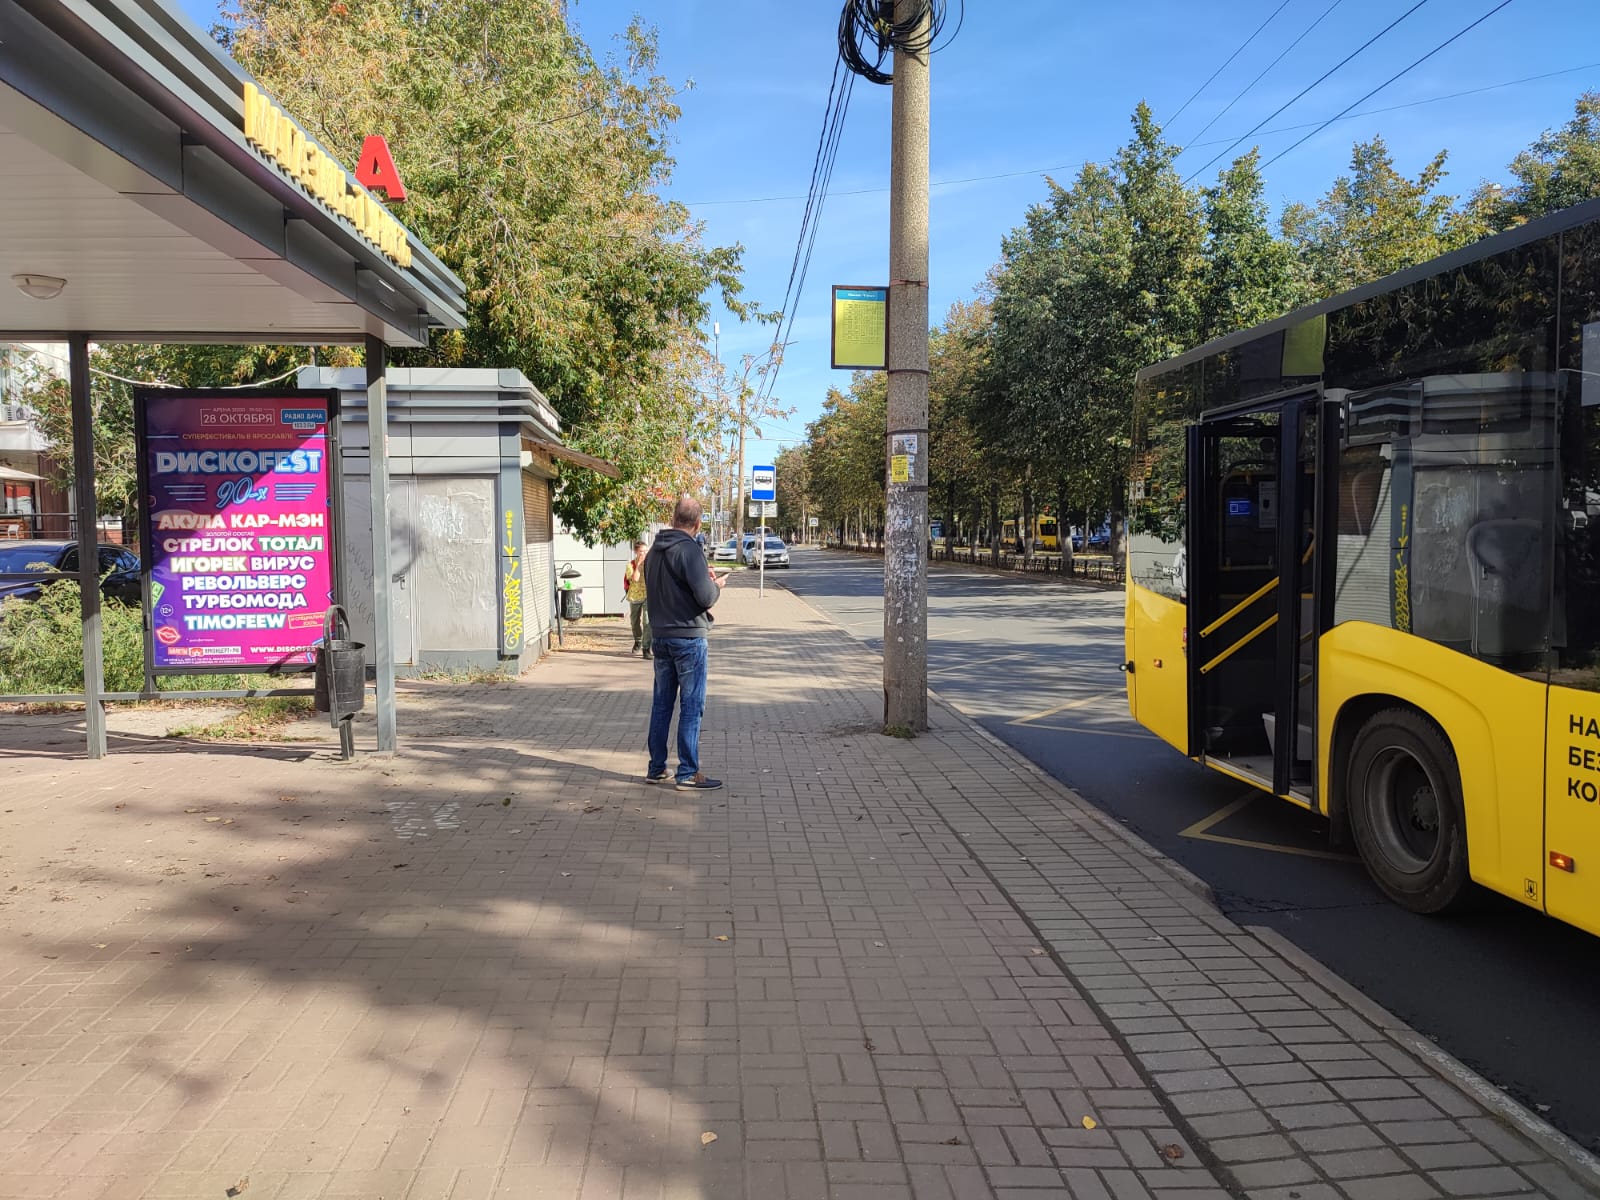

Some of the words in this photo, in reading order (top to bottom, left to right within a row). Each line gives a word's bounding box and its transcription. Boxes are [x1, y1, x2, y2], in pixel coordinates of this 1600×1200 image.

[203, 414, 217, 423] 28
[220, 413, 273, 424] ОКТЯБРЯ
[158, 514, 227, 530] АКУЛА
[231, 514, 324, 528] КАР-МЭН
[163, 538, 254, 552] СТРЕЛОК
[259, 536, 323, 550] ТОТАЛ
[171, 557, 247, 572] ИГОРЕК
[251, 556, 315, 570] ВИРУС
[182, 574, 306, 590] РЕВОЛЬВЕРС
[182, 592, 307, 609] ТУРБОМОДА
[184, 614, 287, 630] TIMOFEEW
[1567, 777, 1600, 804] КО
